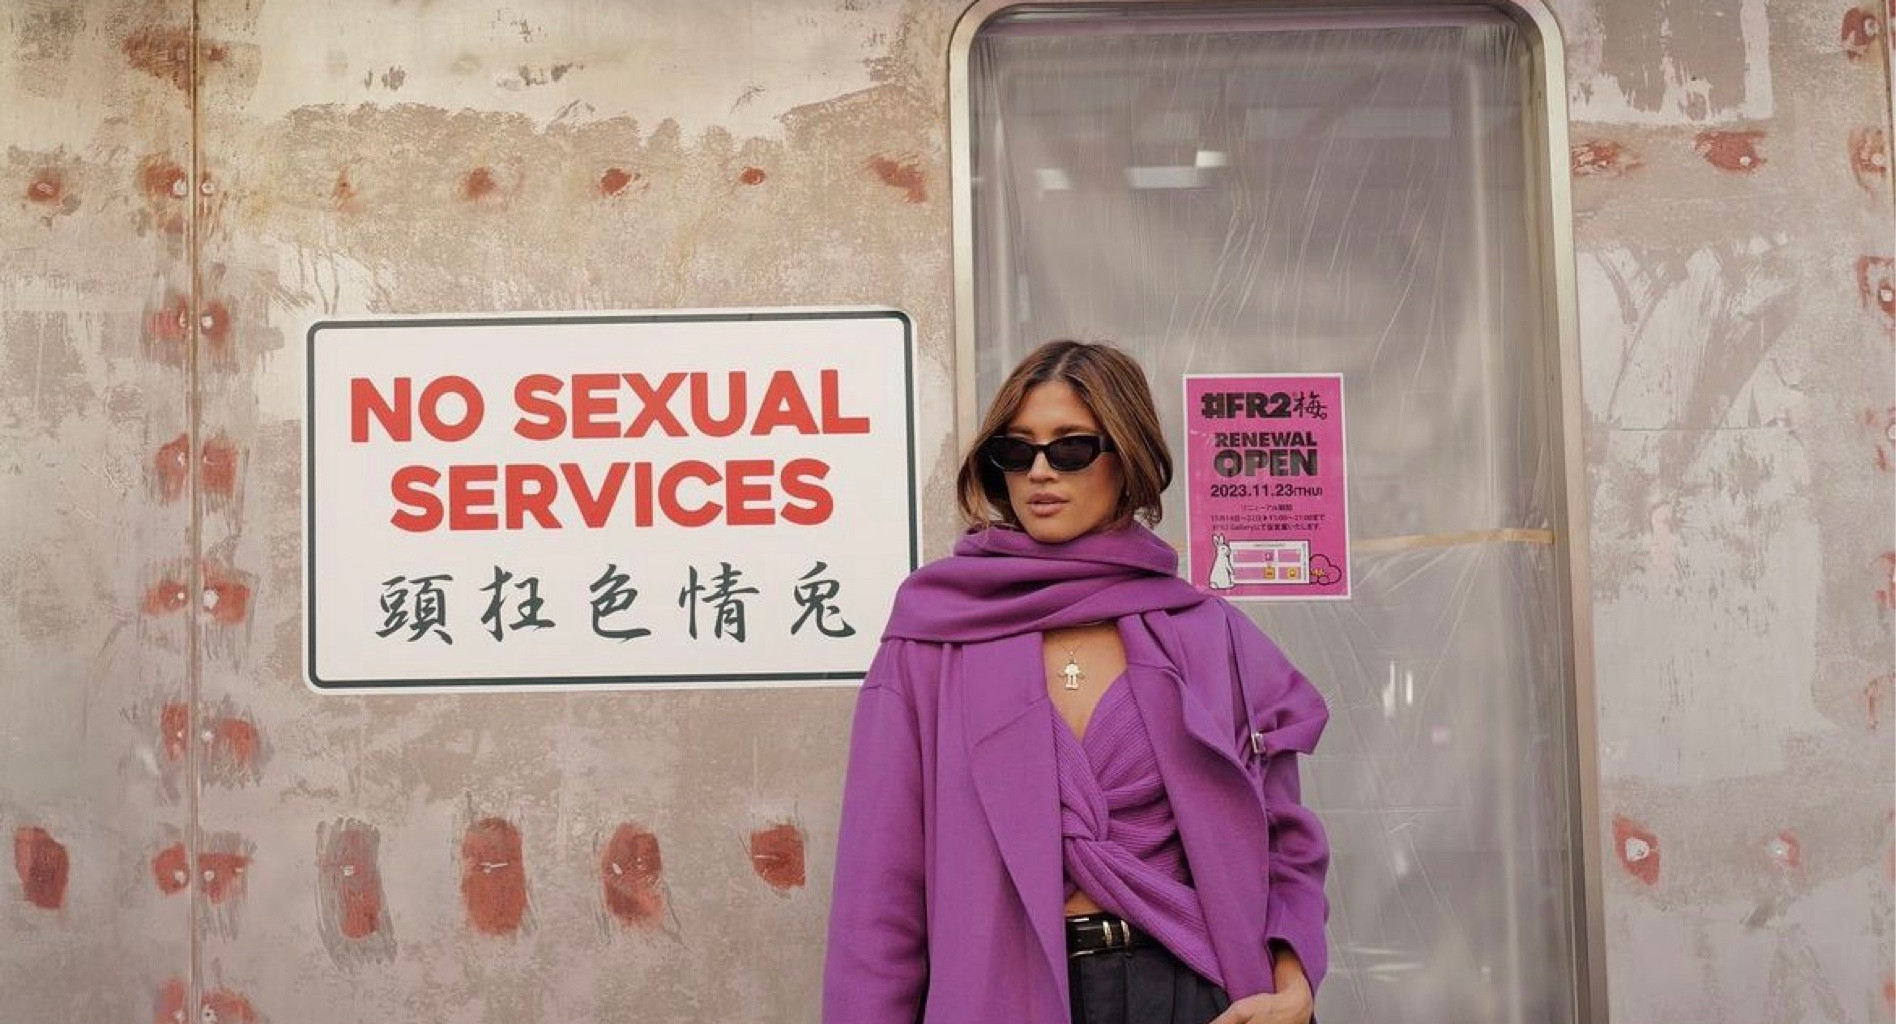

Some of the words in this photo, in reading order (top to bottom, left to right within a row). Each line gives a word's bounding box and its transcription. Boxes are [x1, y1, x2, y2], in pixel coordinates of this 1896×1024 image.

[350, 375, 485, 442] NO
[513, 369, 870, 440] SEXUAL
[1213, 449, 1317, 478] OPEN
[1214, 431, 1317, 448] RENEWAL
[390, 458, 834, 532] SERVICES
